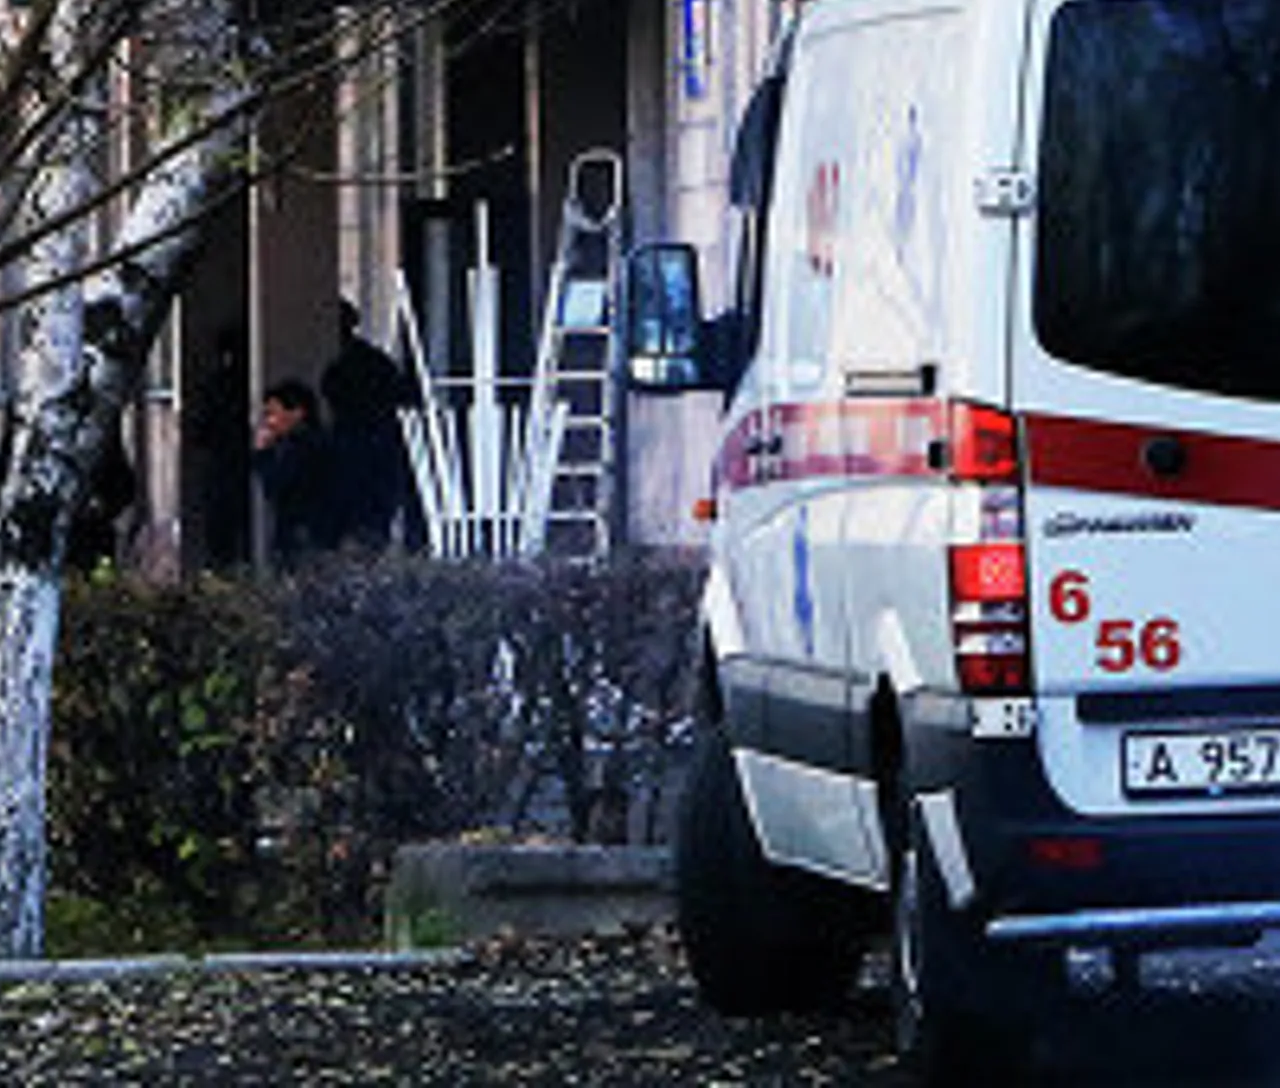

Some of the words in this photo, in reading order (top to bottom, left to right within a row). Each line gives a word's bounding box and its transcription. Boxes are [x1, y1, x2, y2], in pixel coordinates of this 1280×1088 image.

[1049, 569, 1090, 624] 6
[1094, 617, 1181, 673] 56
[1199, 735, 1280, 783] 957
